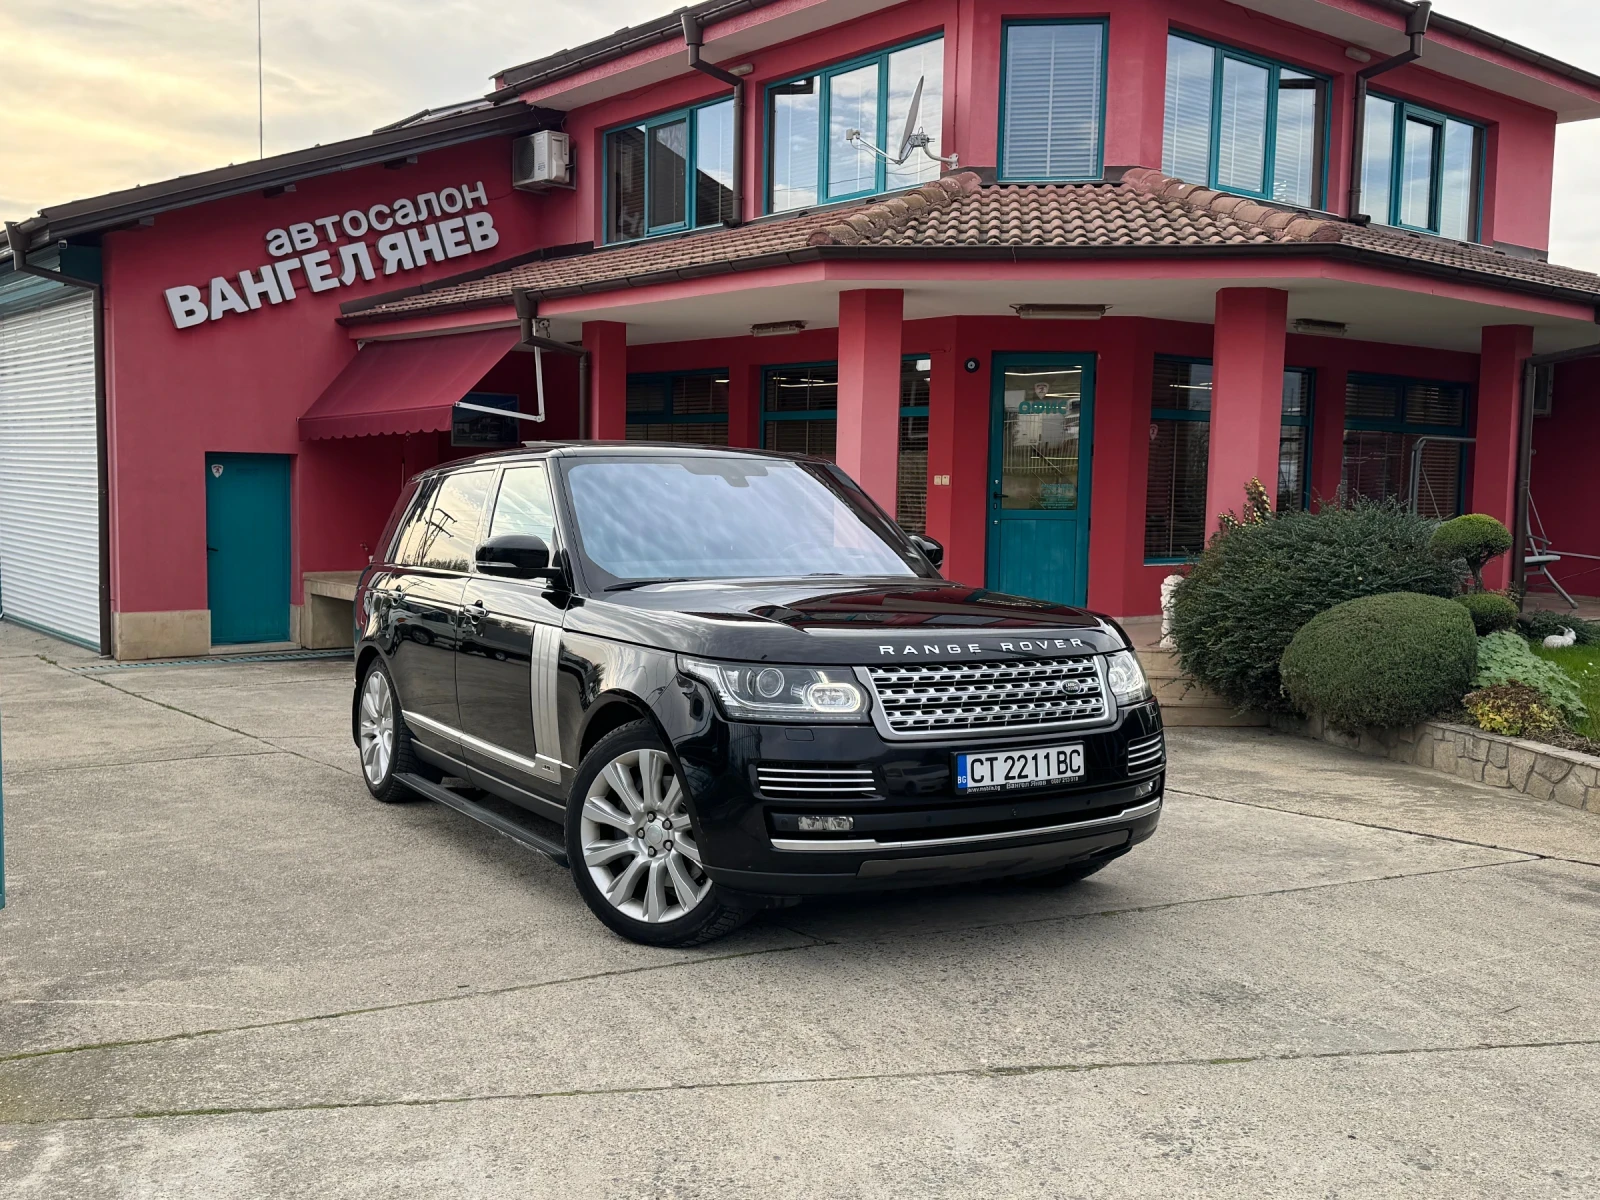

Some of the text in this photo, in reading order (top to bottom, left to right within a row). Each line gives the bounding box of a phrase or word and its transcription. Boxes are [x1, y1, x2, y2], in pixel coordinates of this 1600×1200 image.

[265, 181, 489, 257] автосалон
[163, 211, 500, 329] ВАНГЕЛ ЯНЕВ
[879, 638, 1084, 655] RANGE ROVER
[957, 775, 967, 785] BG
[1003, 752, 1051, 781] 2211
